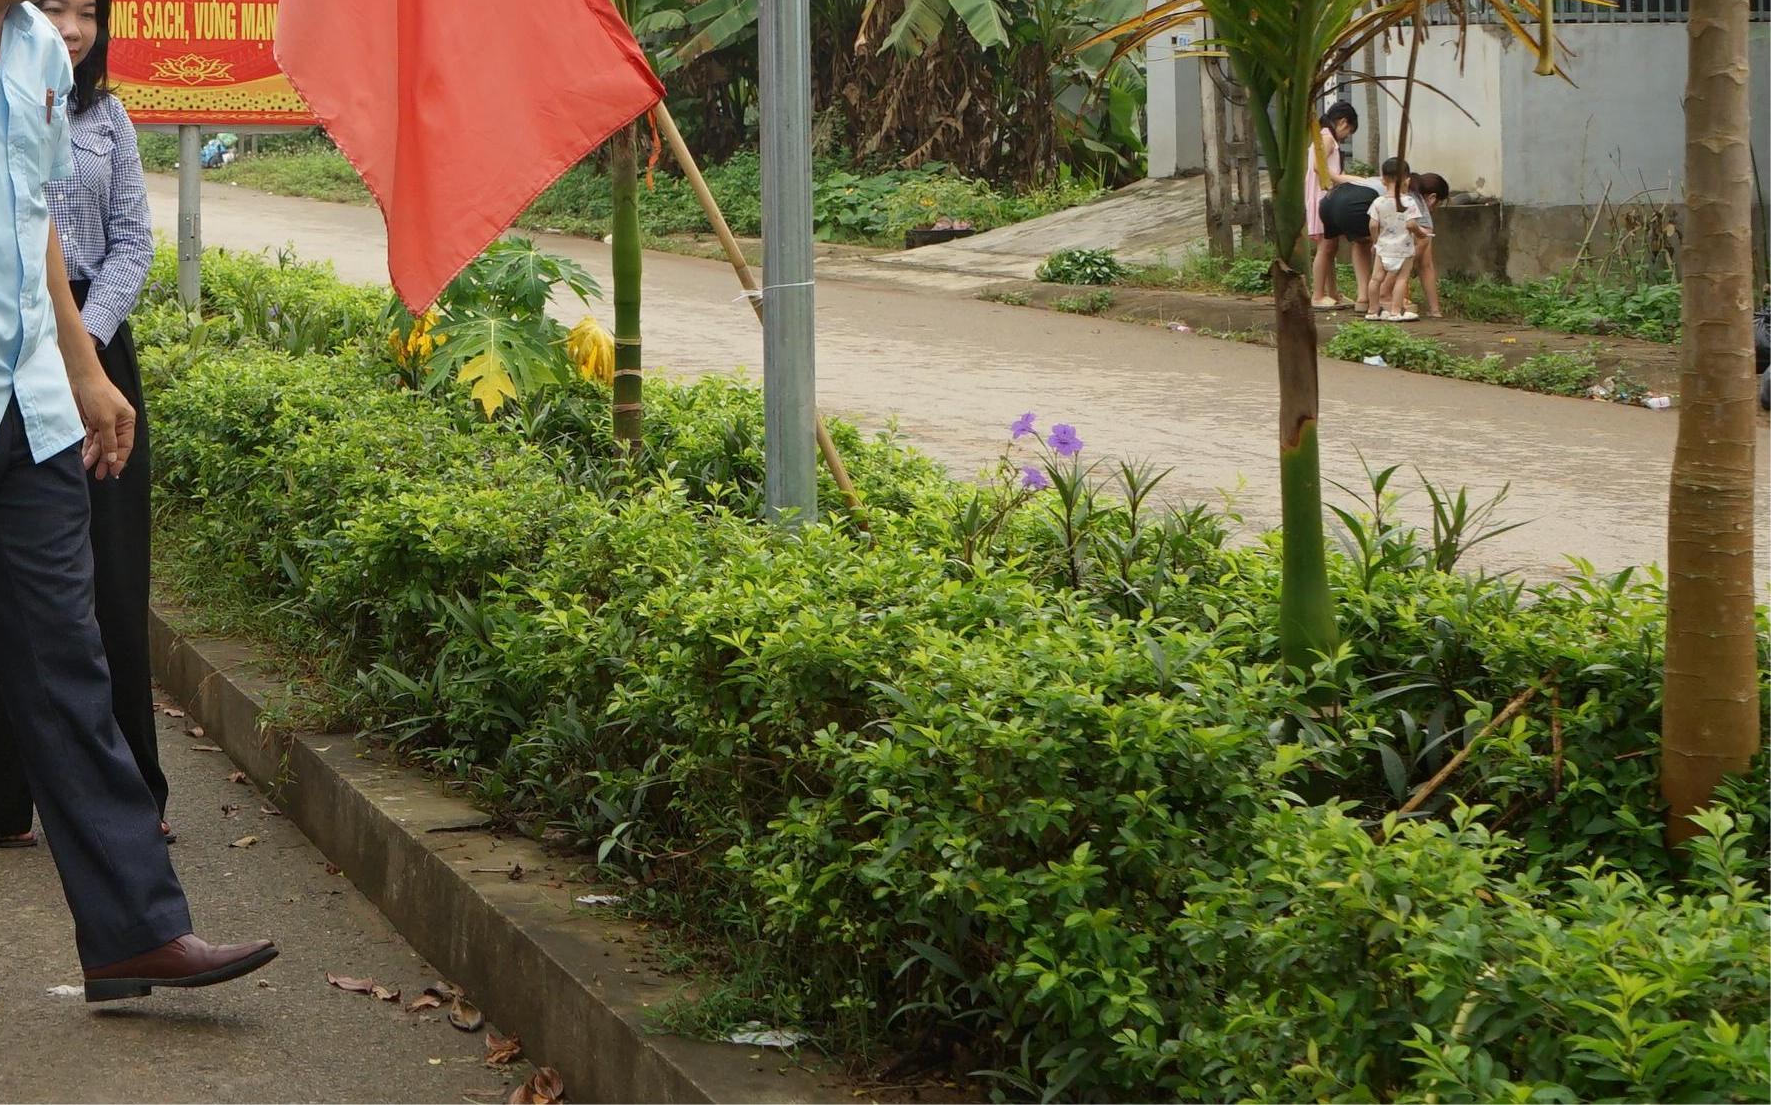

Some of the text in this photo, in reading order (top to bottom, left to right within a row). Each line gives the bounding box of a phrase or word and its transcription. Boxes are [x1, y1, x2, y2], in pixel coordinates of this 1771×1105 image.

[108, 0, 138, 40] ONG
[143, 1, 189, 48] SẠCH,
[241, 2, 278, 49] MẠN
